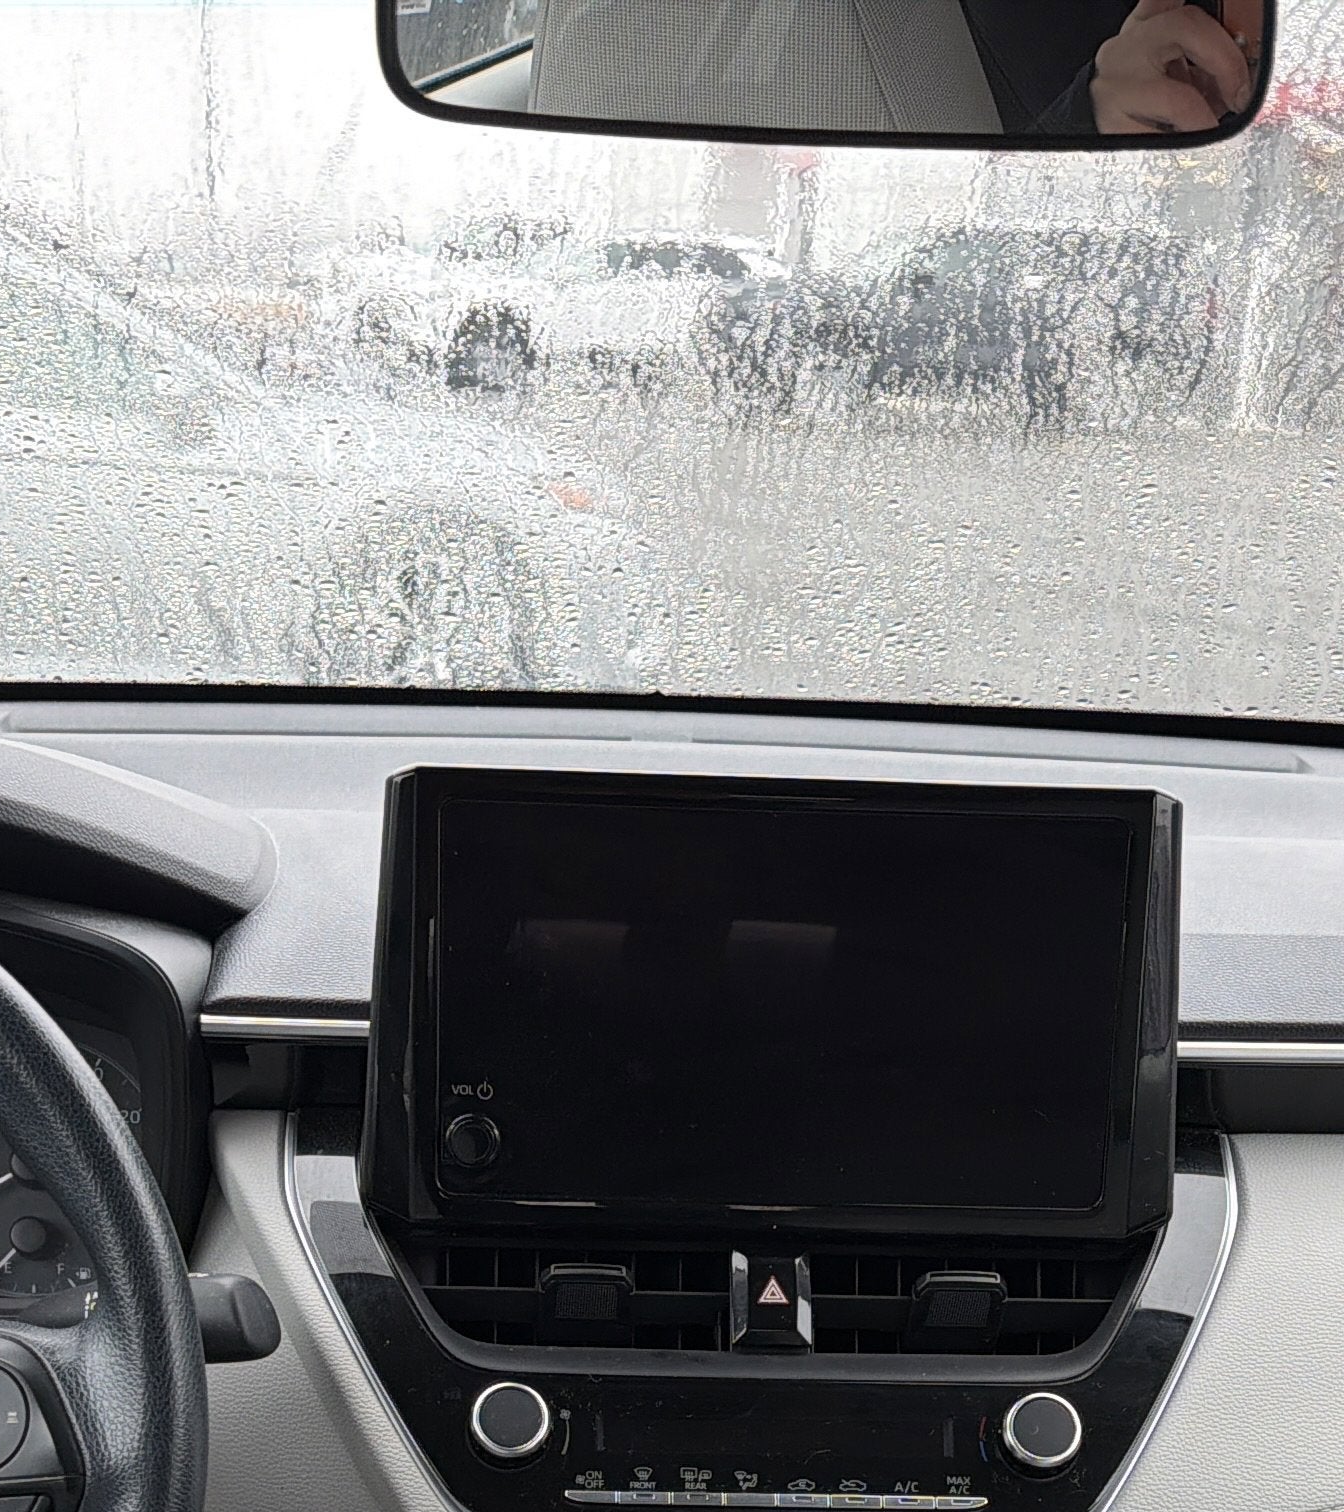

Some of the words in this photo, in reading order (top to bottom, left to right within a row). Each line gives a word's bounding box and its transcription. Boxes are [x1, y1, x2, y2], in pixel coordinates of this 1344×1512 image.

[451, 1084, 474, 1095] VOL
[4, 1263, 12, 1274] E
[57, 1263, 65, 1275] F
[585, 1470, 603, 1479] ON
[585, 1479, 605, 1489] OFF
[630, 1481, 657, 1489] FRONT
[684, 1482, 707, 1490] REAR
[946, 1476, 971, 1486] MAX
[894, 1481, 919, 1493] A/C
[949, 1485, 970, 1495] A/C
